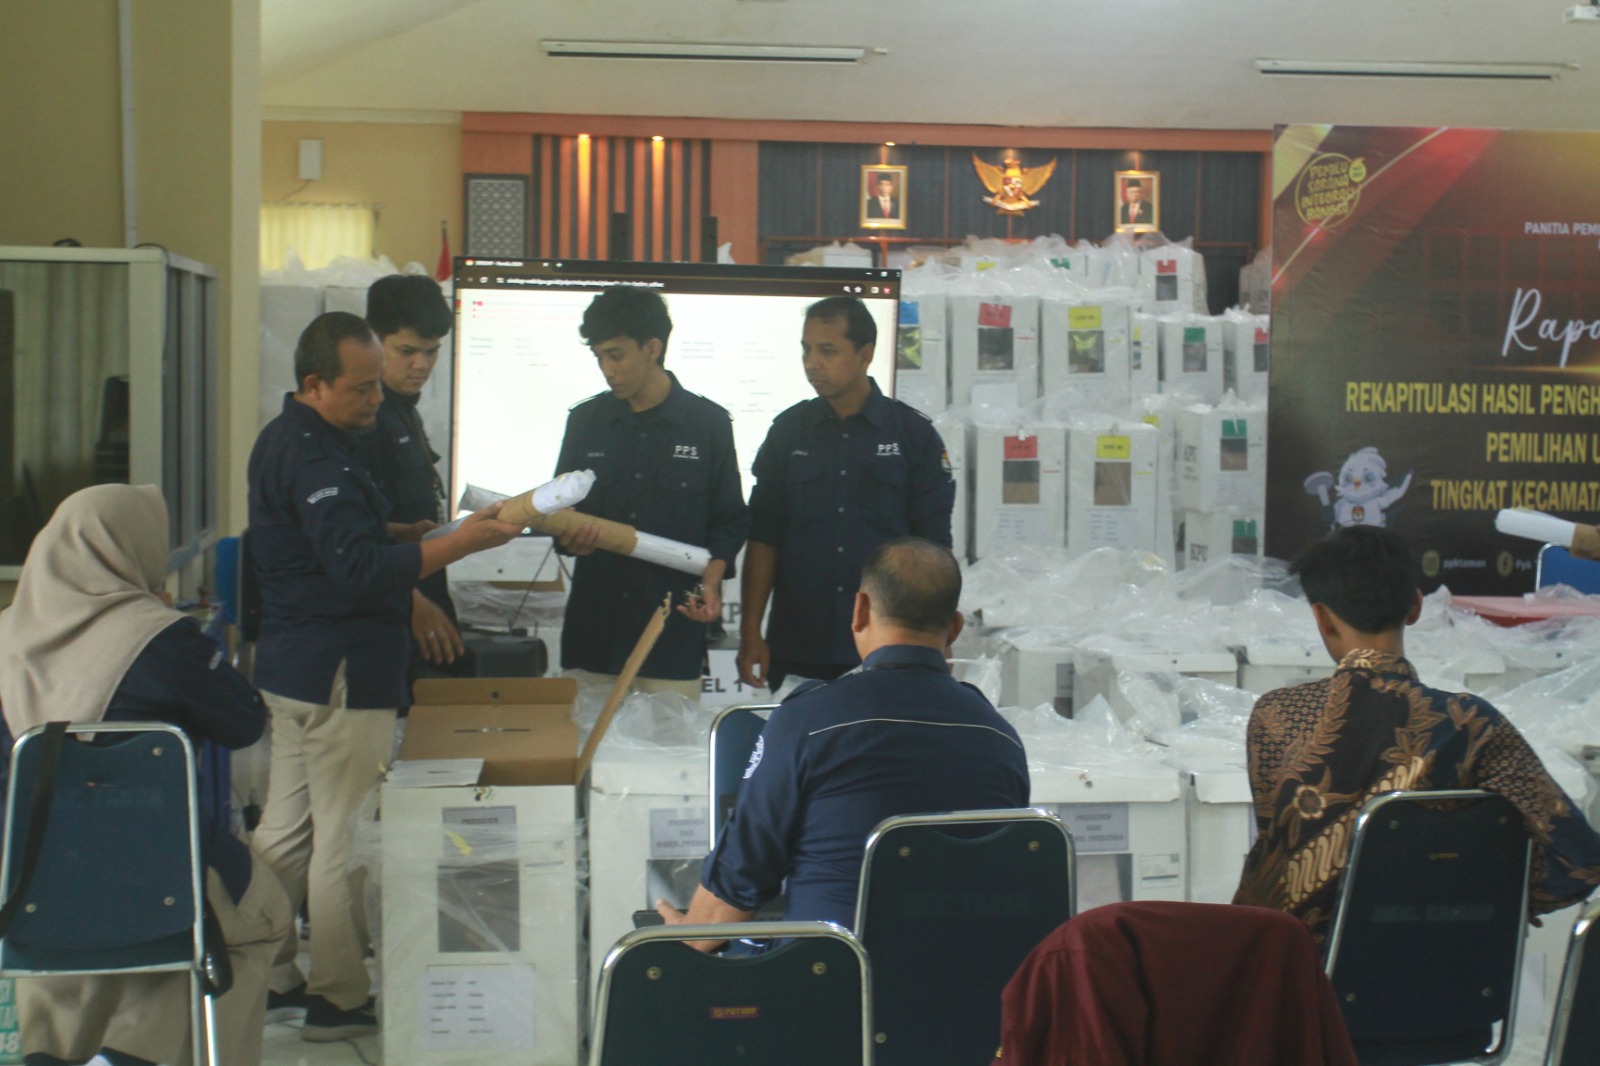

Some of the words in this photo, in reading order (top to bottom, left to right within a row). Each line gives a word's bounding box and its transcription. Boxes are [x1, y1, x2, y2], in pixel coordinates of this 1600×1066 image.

[1524, 221, 1570, 235] PANITIA
[1346, 381, 1477, 414] REKAPITULASI
[1482, 383, 1535, 415] HASIL
[1541, 384, 1600, 416] PENGH
[675, 445, 697, 456] PPS
[877, 443, 899, 453] PPS
[1486, 432, 1587, 463] PEMILIHAN
[1431, 480, 1507, 510] TINGKAT
[1512, 481, 1600, 512] KECAMAT
